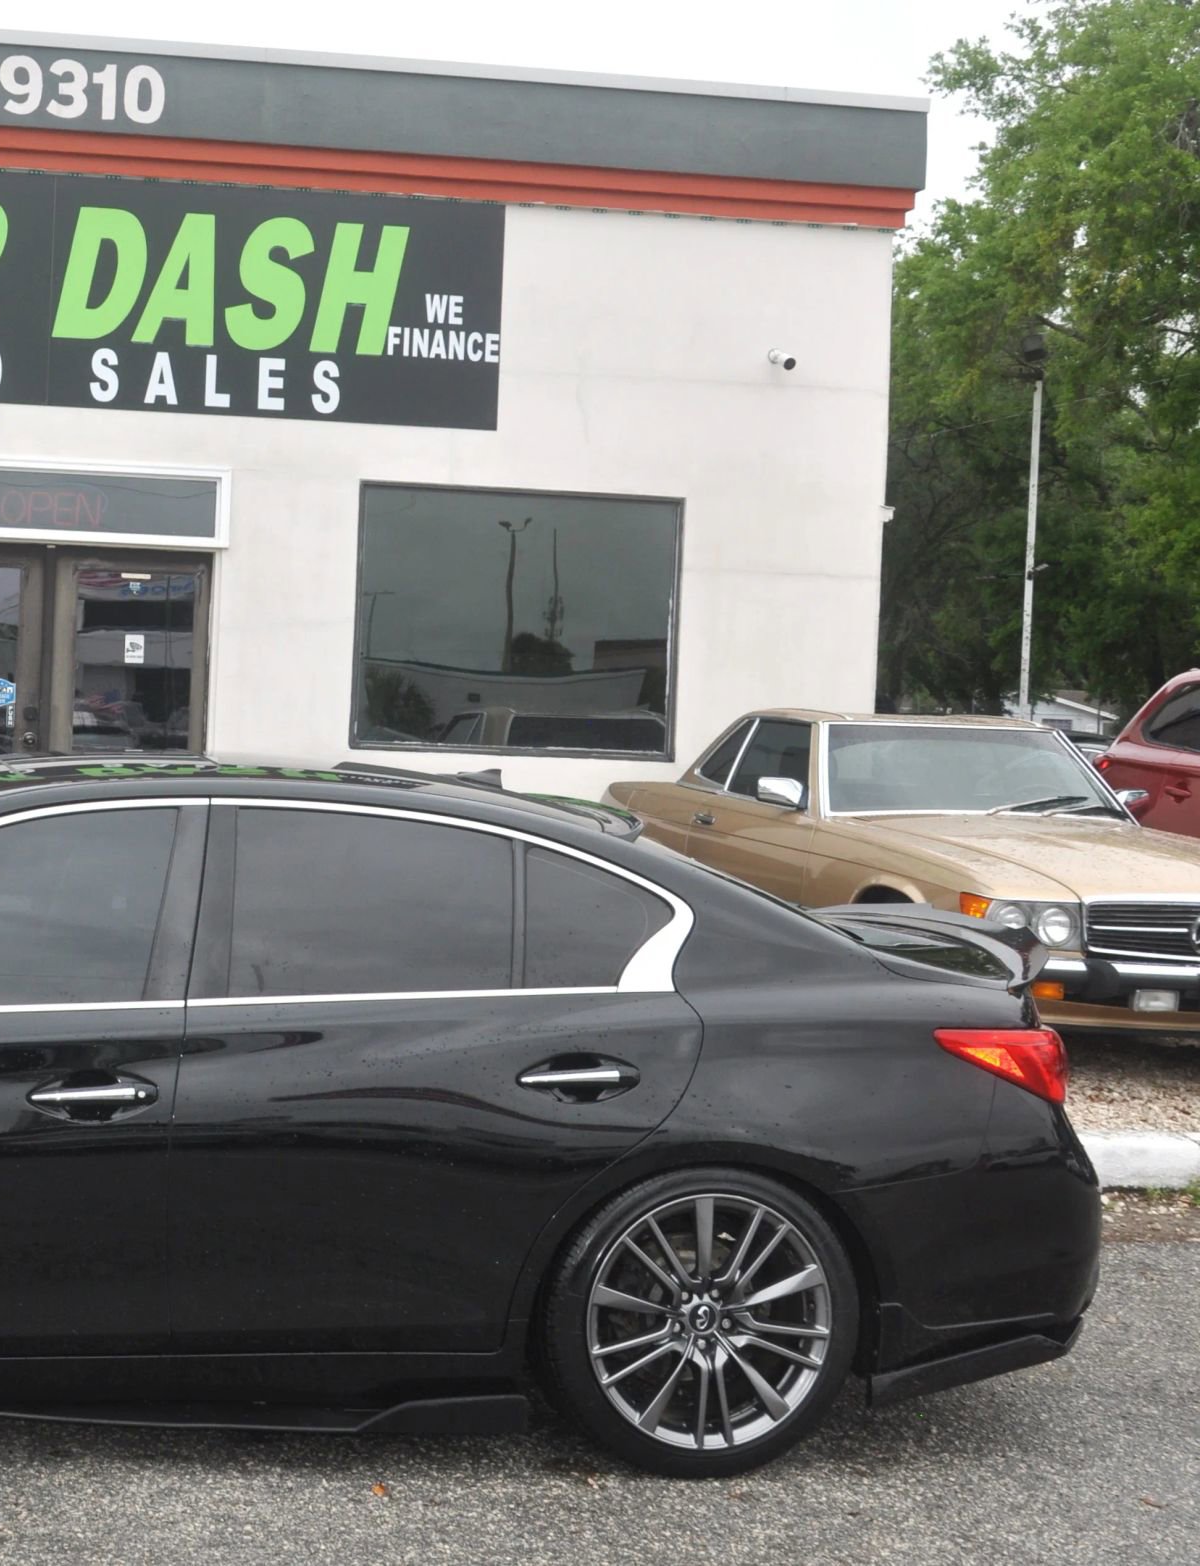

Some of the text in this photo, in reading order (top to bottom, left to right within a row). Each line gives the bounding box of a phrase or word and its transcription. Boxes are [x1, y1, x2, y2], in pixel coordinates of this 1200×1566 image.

[51, 206, 410, 357] DASH
[424, 293, 464, 326] WE
[387, 326, 500, 364] FINANCE
[89, 347, 341, 415] SALES
[0, 490, 102, 528] OPEN
